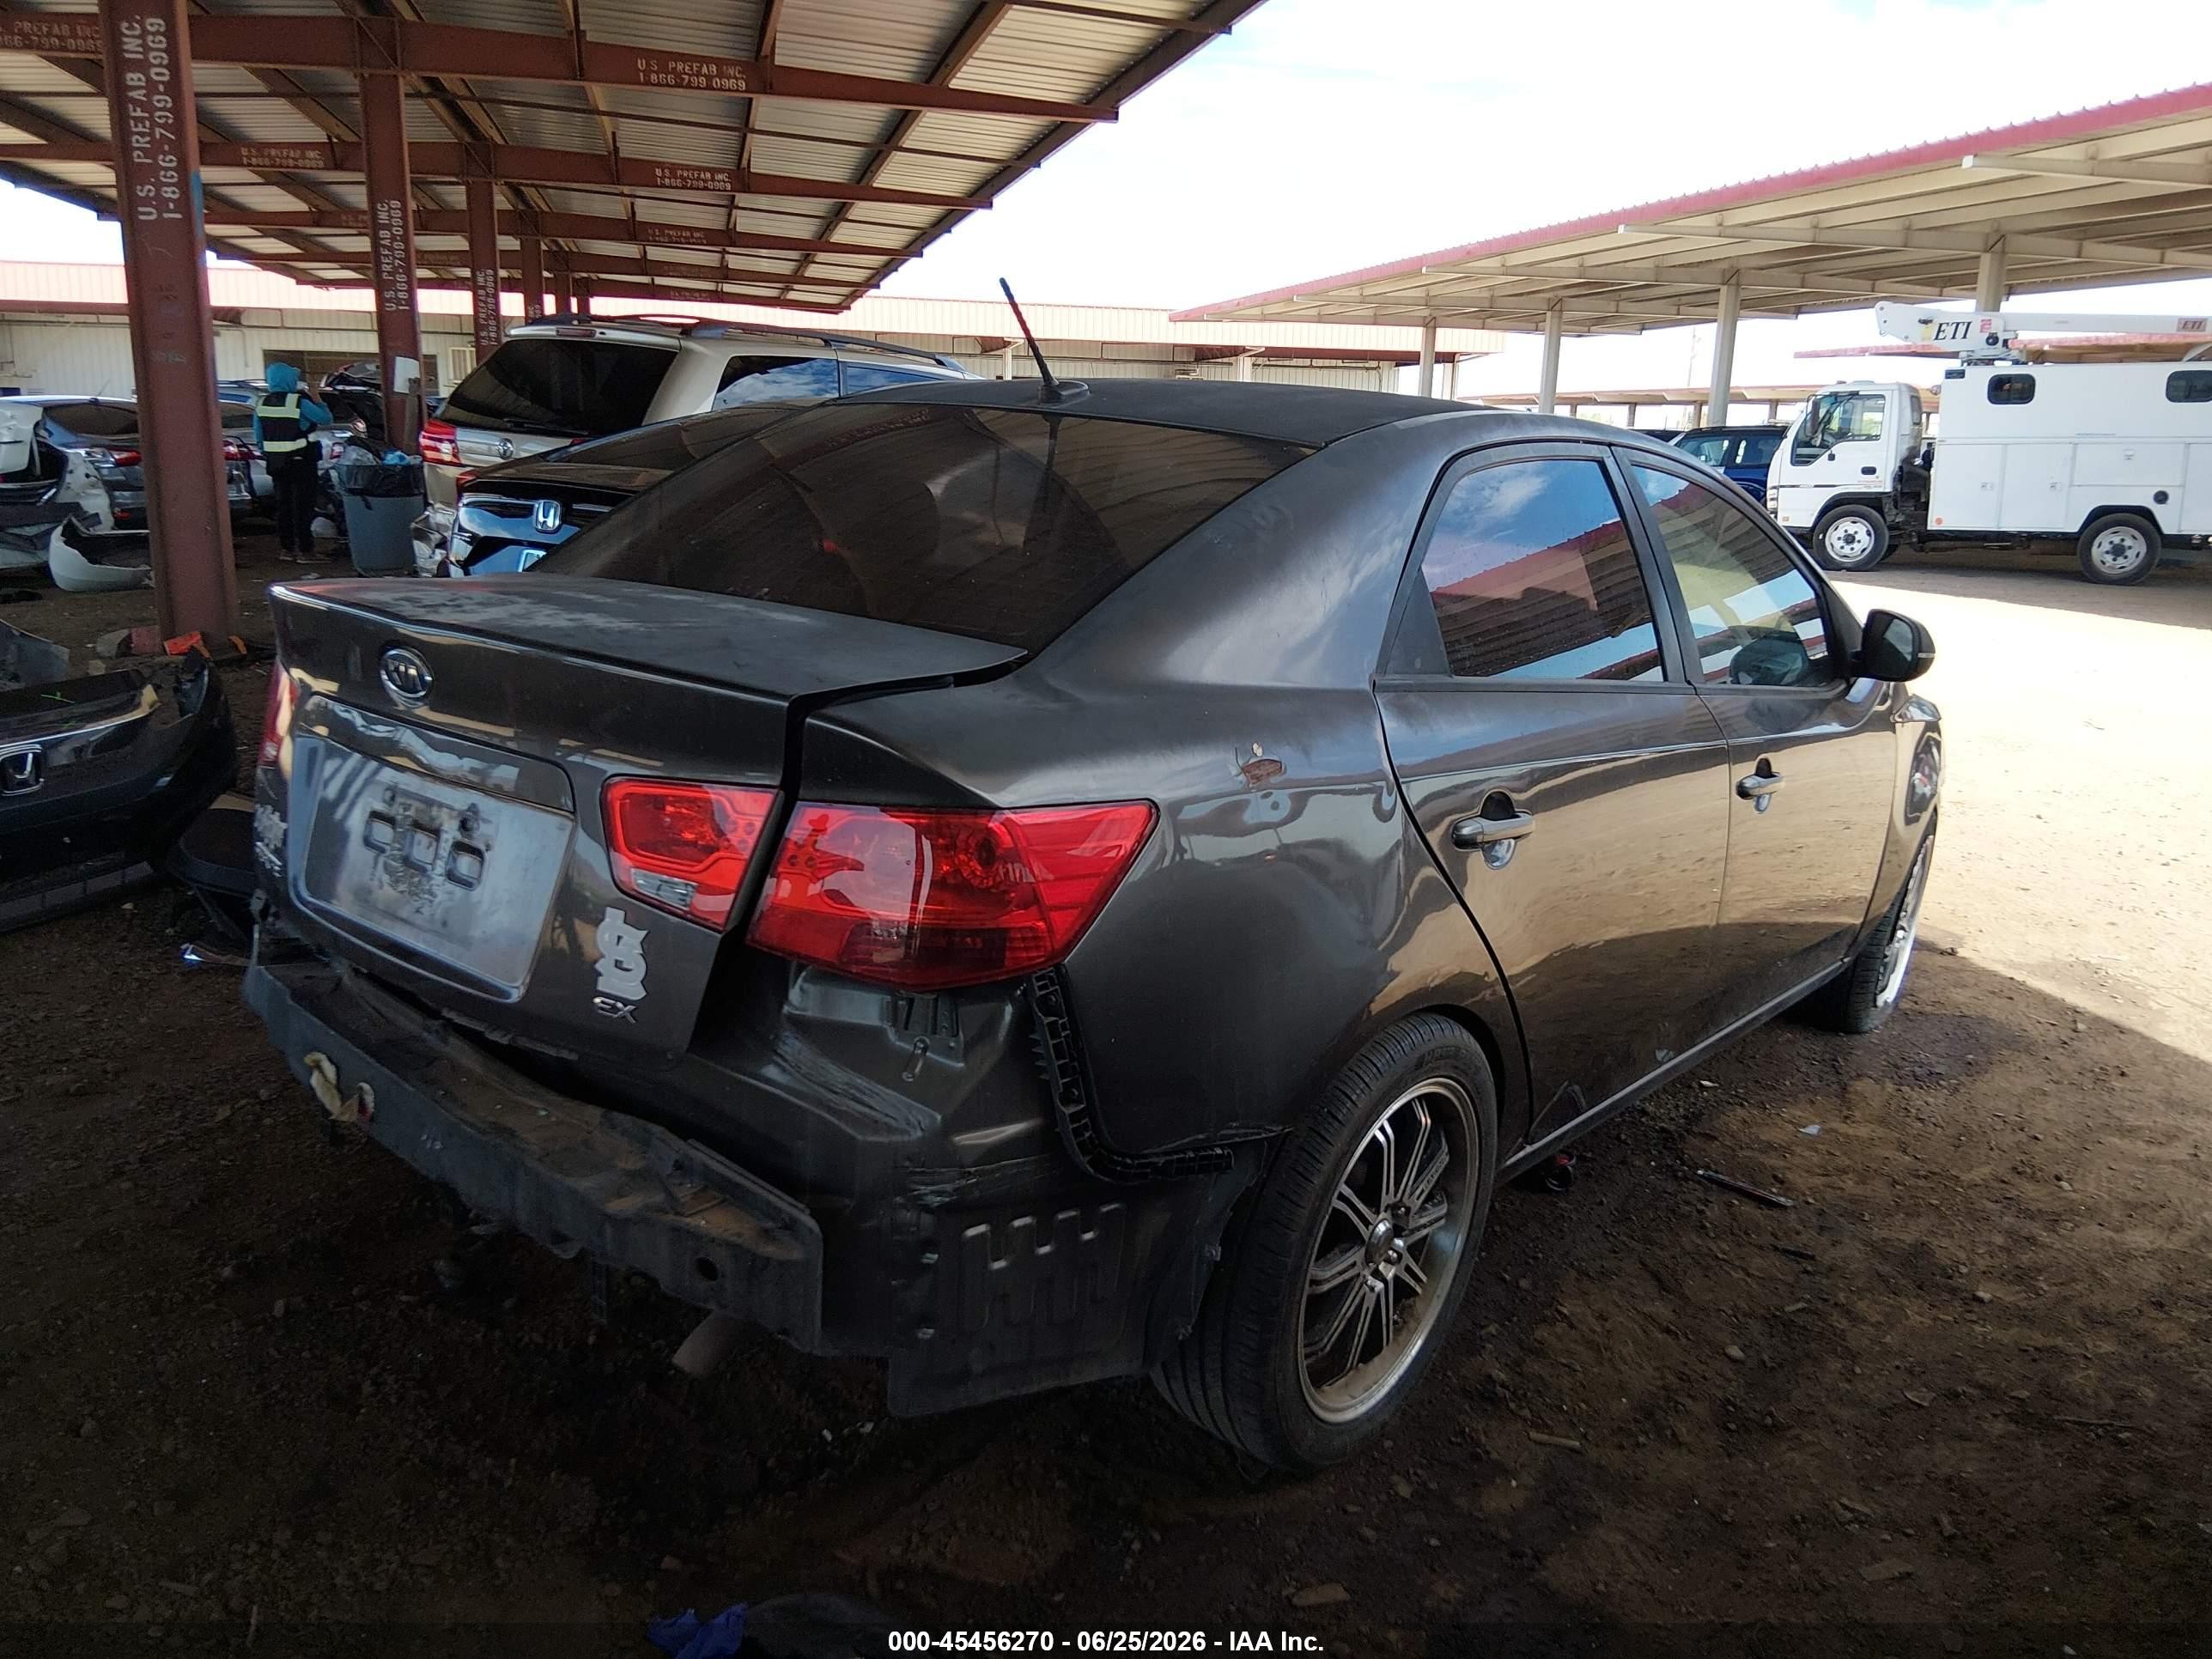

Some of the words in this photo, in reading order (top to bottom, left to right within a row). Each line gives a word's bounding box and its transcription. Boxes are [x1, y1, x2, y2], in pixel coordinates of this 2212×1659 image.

[120, 15, 144, 59] INC.
[668, 61, 717, 76] PREFAB
[126, 72, 153, 163] PREFAB
[145, 17, 183, 219] 1-866-799-0969
[677, 170, 711, 180] PREFAB
[136, 178, 158, 220] U.S.
[378, 199, 390, 223] INC.
[379, 230, 394, 279] PREFAB
[1934, 320, 1973, 341] ETI
[2181, 319, 2203, 331] ETI
[592, 996, 636, 1024] EX
